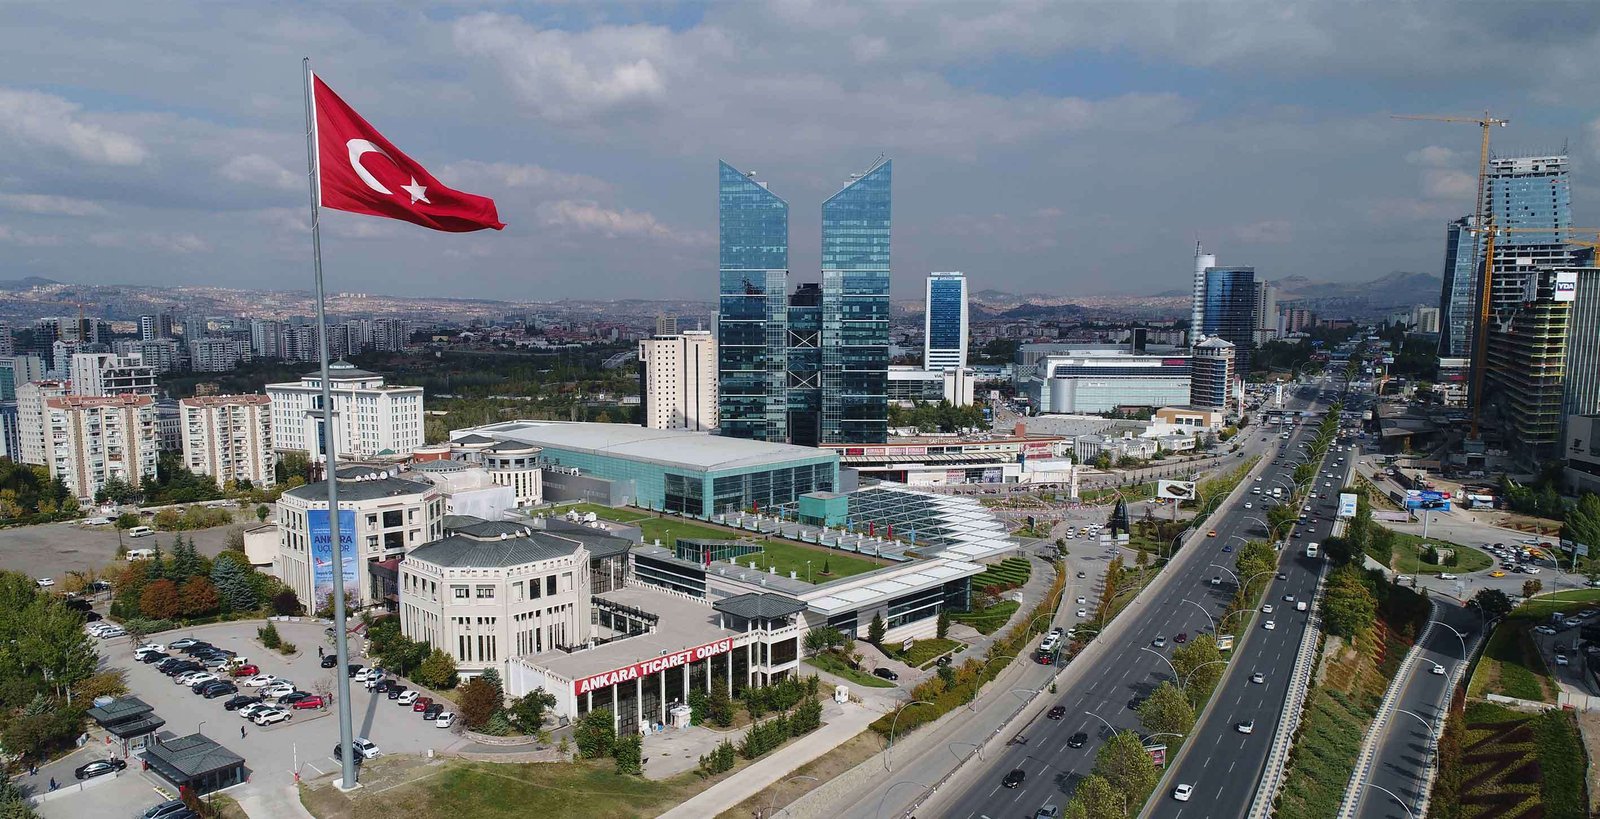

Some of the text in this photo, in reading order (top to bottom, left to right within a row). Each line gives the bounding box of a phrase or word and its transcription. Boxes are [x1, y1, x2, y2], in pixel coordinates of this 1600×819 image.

[314, 535, 352, 543] ANKRA
[580, 667, 638, 693] ANKARA
[696, 640, 730, 659] ODASI
